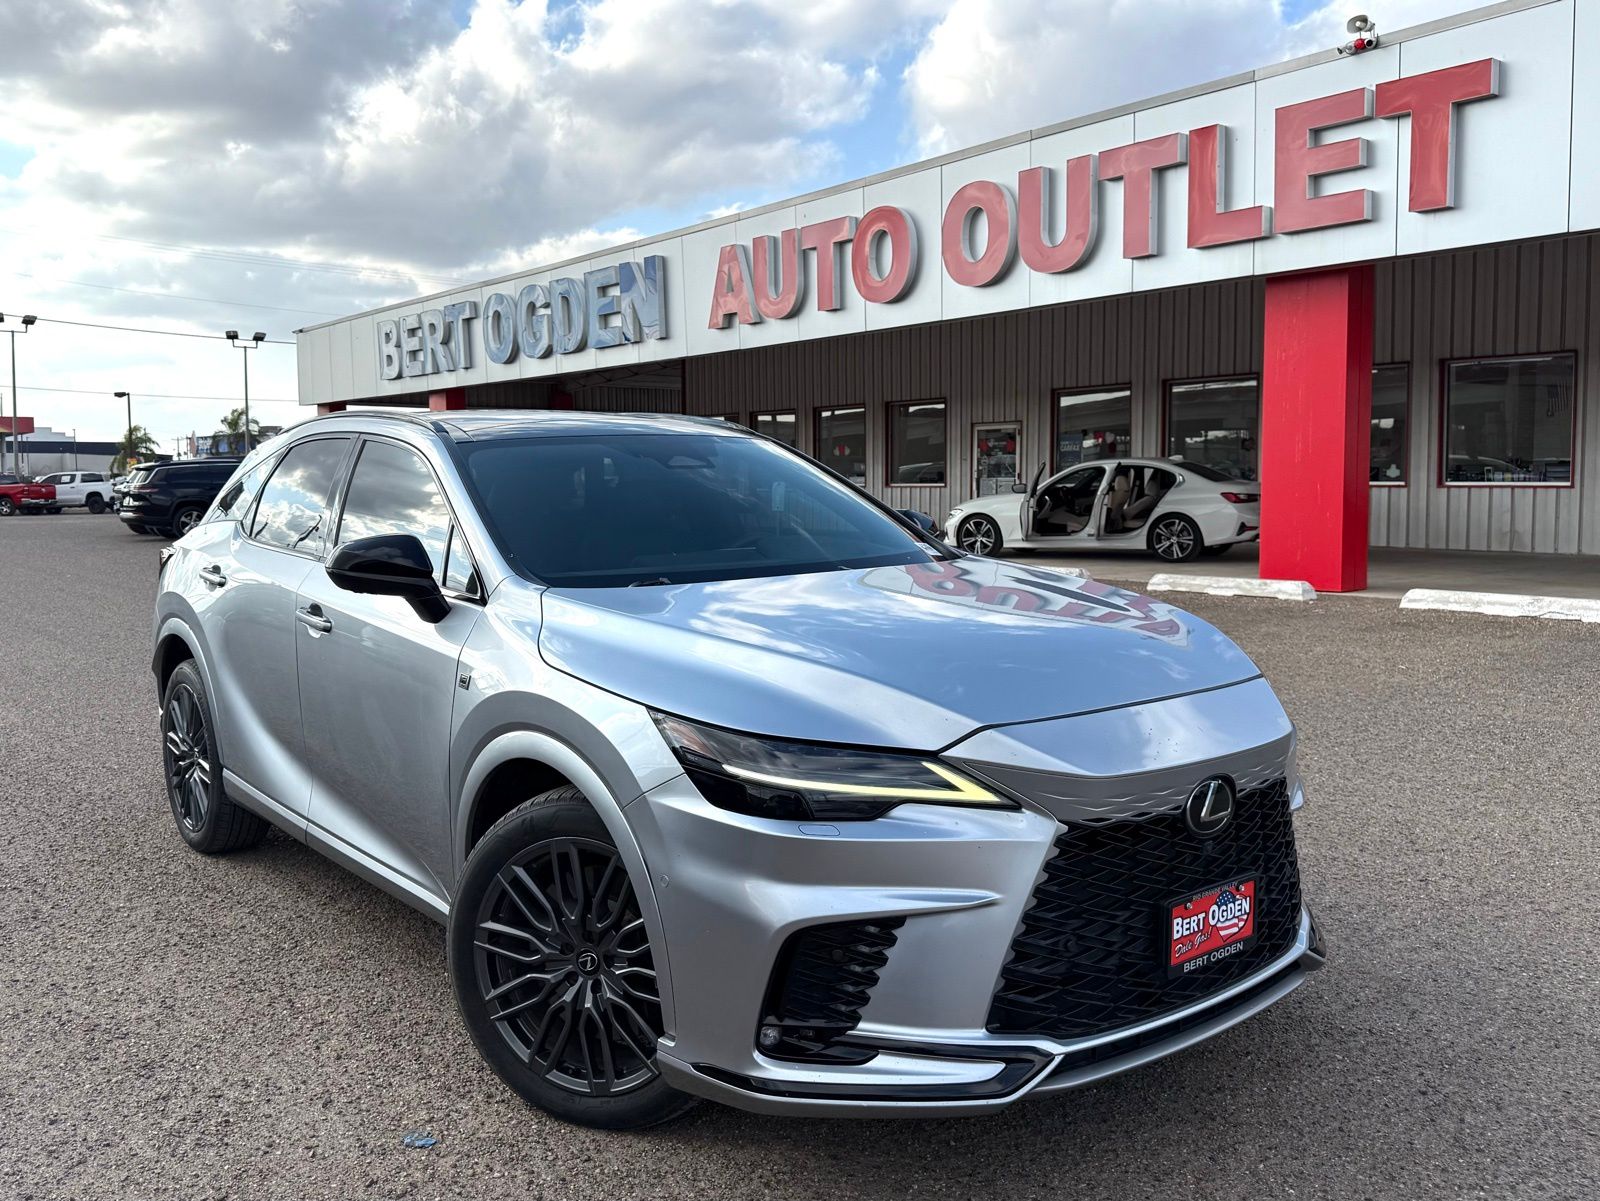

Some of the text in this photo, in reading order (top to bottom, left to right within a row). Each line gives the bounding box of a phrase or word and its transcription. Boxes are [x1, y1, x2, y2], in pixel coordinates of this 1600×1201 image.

[377, 57, 1502, 380] BERT OGDEN AUTO OUTLET
[1173, 896, 1250, 940] BERT OGDEN
[1183, 941, 1244, 973] BERT OGDEN
